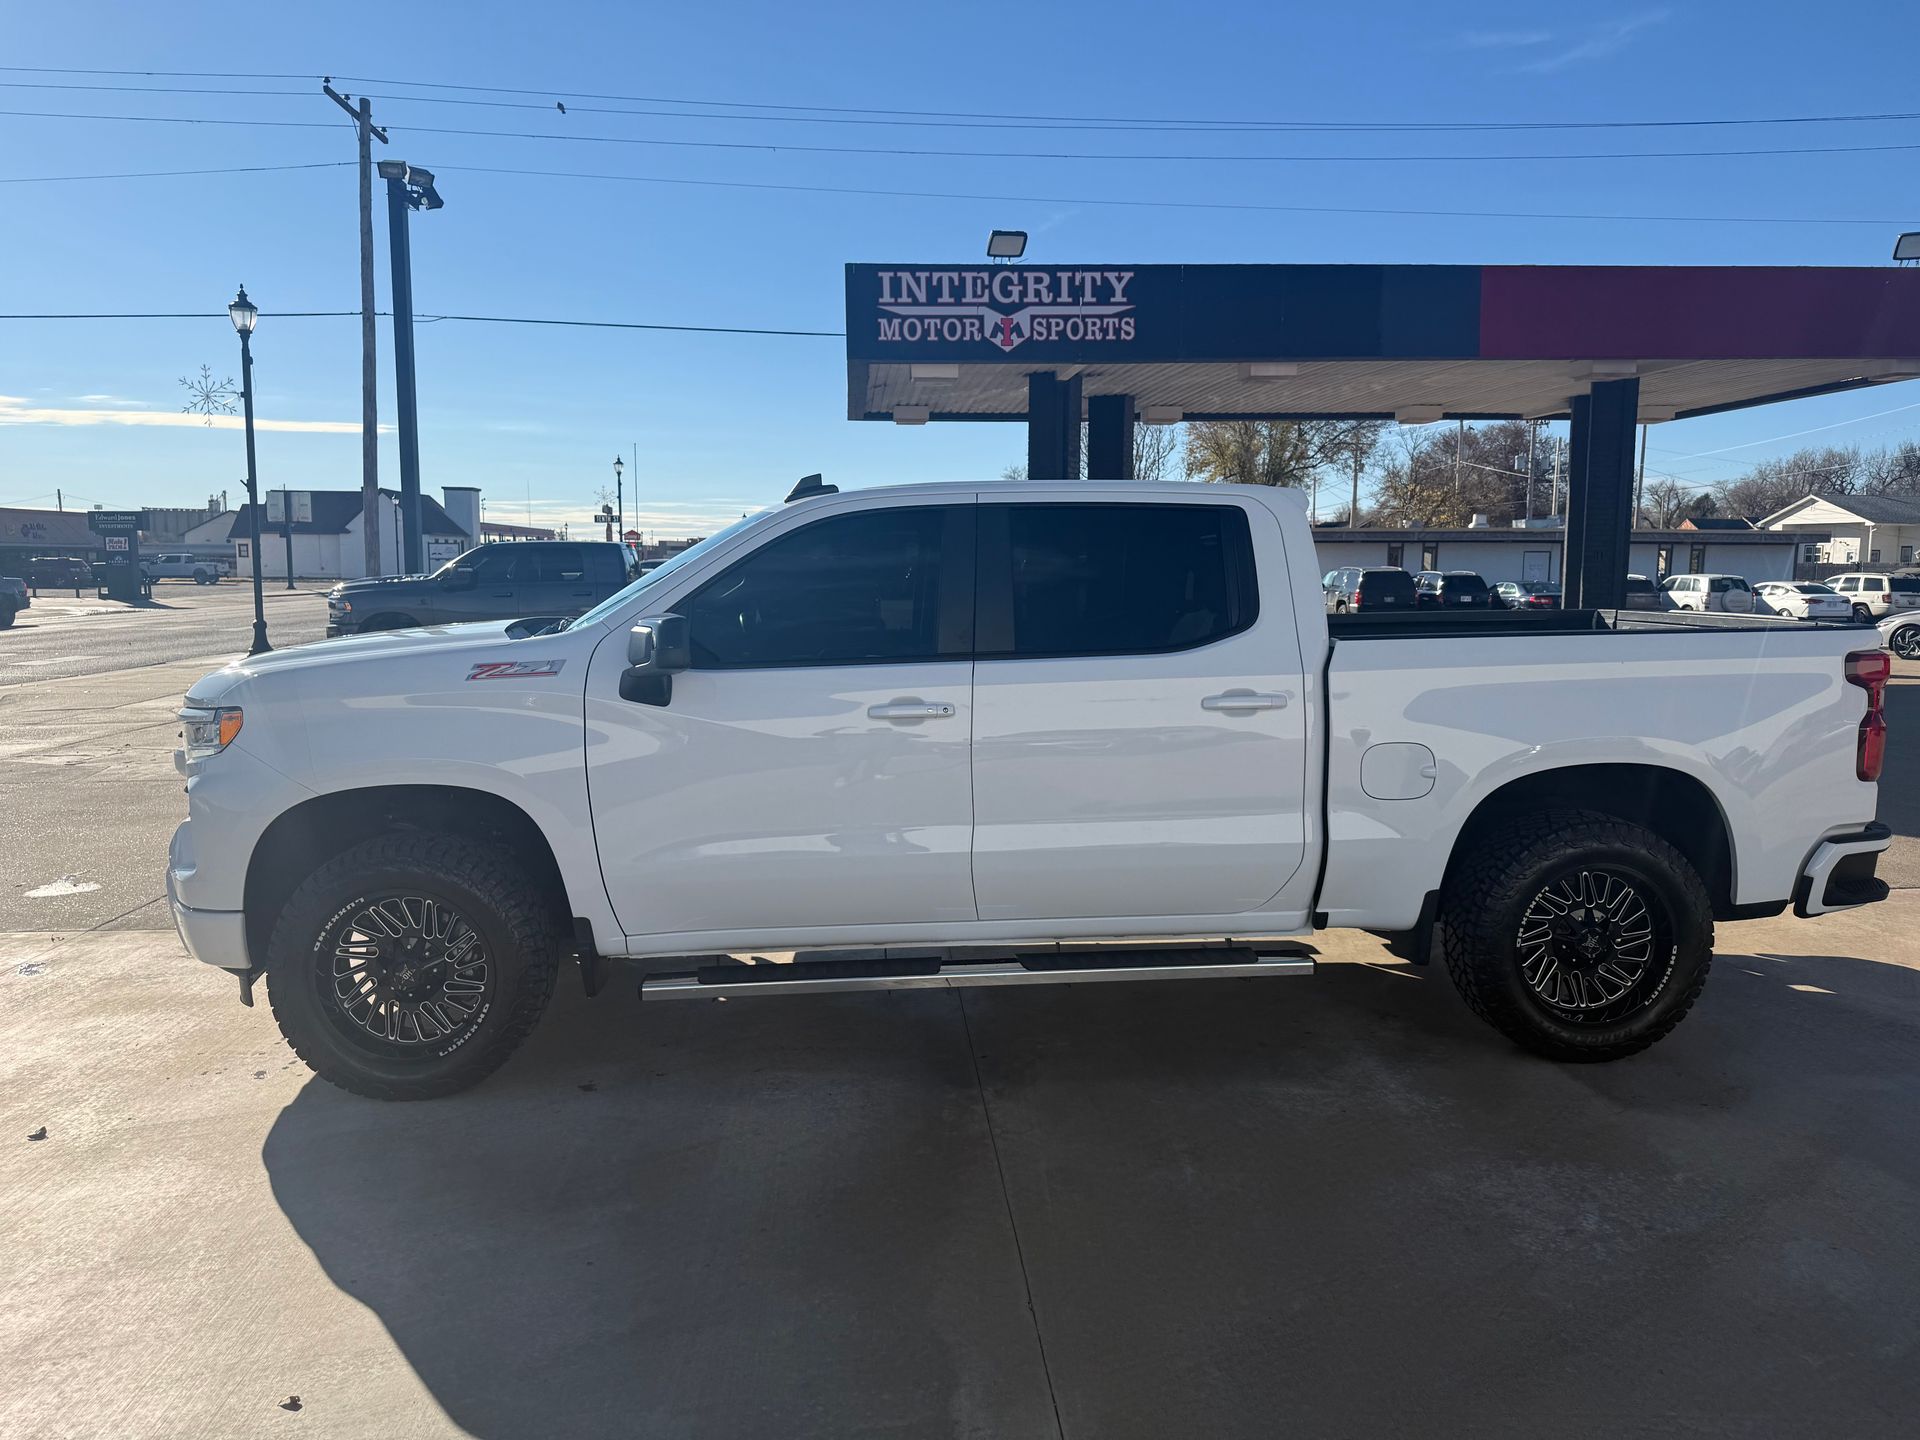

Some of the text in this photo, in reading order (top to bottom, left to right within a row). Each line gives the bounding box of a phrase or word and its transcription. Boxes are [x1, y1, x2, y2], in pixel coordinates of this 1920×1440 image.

[878, 271, 1135, 303] INTEGRITY
[878, 317, 1136, 341] MOTOR SPORTS
[465, 659, 568, 681] Z71
[313, 897, 365, 952] LUXXX HD
[439, 1003, 490, 1057] LUXXX HD
